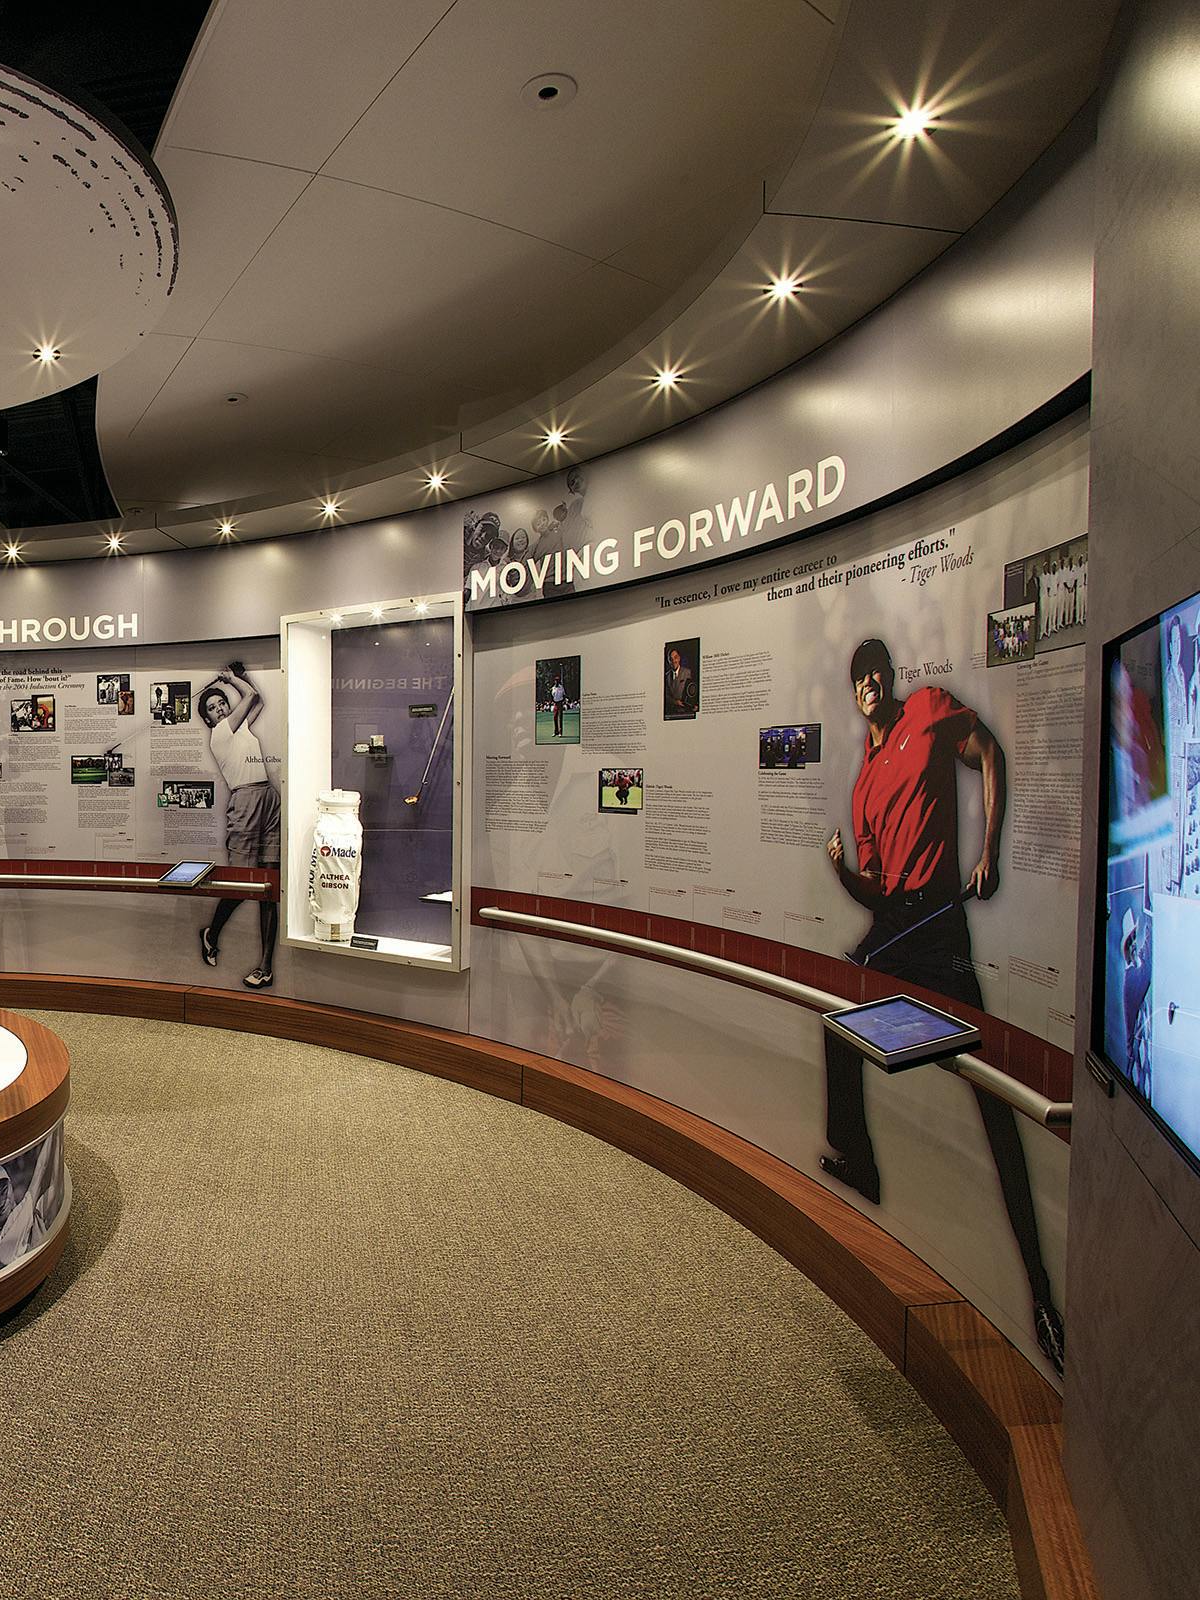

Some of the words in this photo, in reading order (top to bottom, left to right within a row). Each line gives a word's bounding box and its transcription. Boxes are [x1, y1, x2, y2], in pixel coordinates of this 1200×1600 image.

[470, 538, 620, 601] MOVING
[633, 455, 846, 568] FORWARD
[767, 586, 793, 601] them
[795, 577, 815, 595] and
[818, 570, 843, 588] their
[845, 554, 905, 585] pioneering
[908, 528, 956, 561] efforts."
[911, 565, 938, 586] Tiger
[940, 546, 974, 574] Woods
[673, 589, 711, 605] essence,
[720, 583, 740, 595] owe
[743, 577, 759, 592] my
[761, 568, 790, 585] entire
[792, 559, 824, 576] career
[826, 555, 837, 566] to
[1, 667, 11, 675] the
[898, 664, 921, 683] Tiger
[923, 659, 953, 676] Woods
[0, 675, 6, 683] of
[245, 755, 264, 763] Althea
[331, 845, 356, 858] Made
[320, 873, 350, 881] ALTHEA
[321, 881, 349, 889] GIBSON
